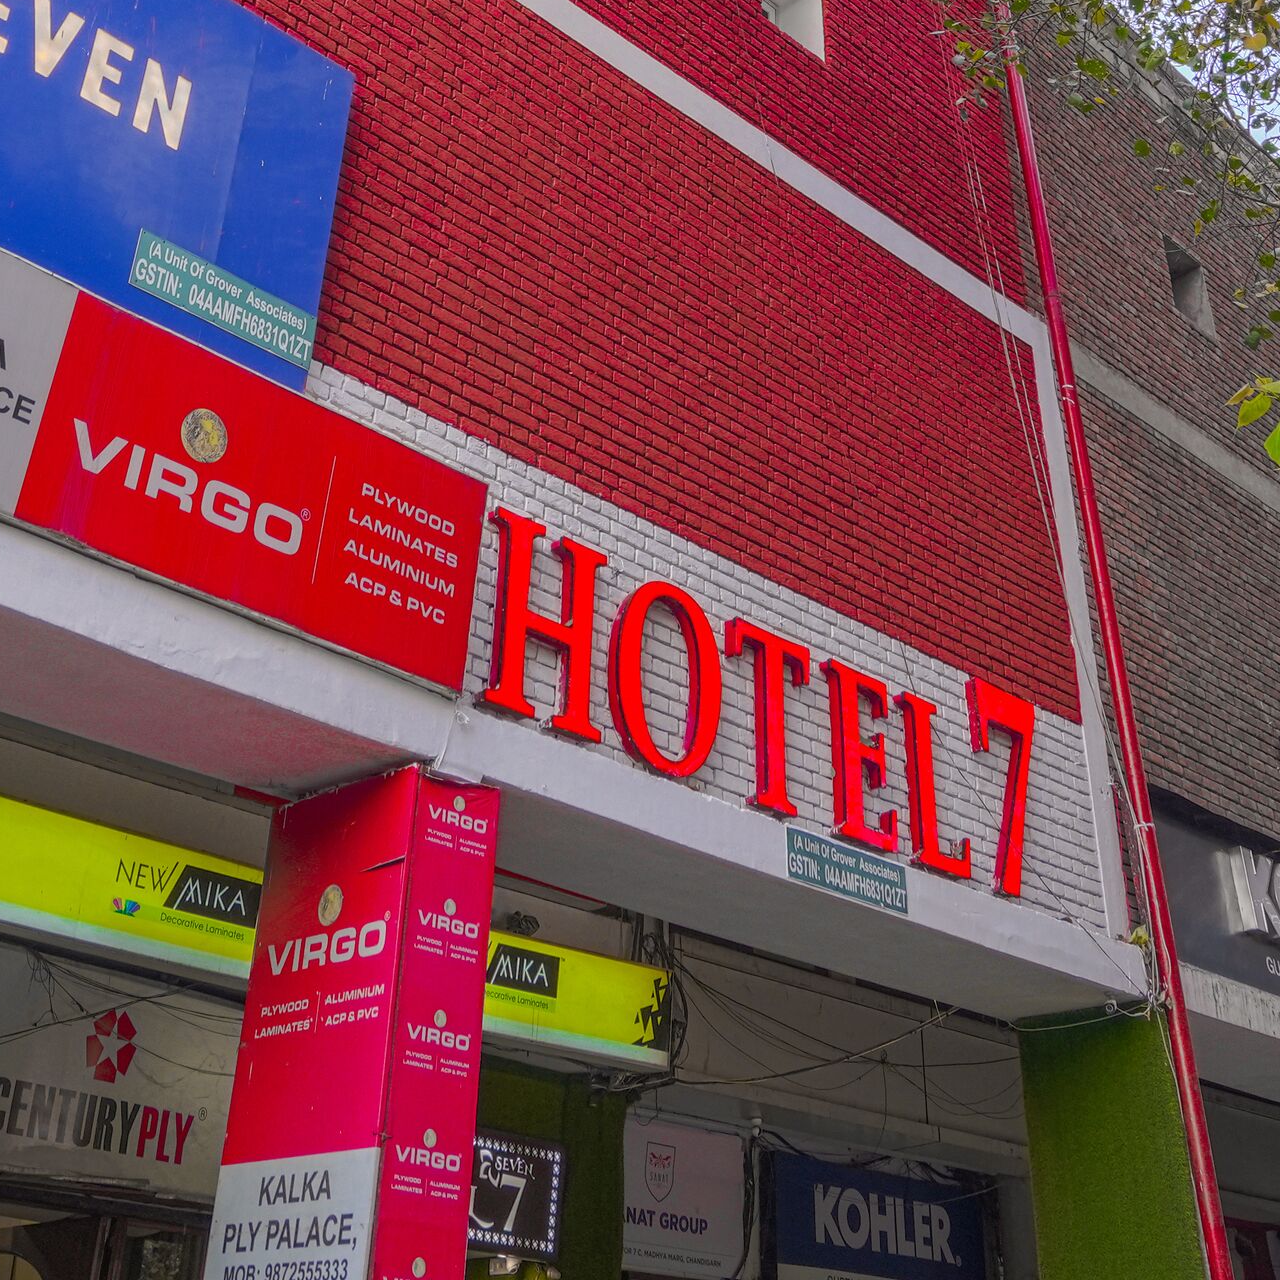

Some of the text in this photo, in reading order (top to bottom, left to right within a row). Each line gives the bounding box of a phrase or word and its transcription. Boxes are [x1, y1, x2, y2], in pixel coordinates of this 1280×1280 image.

[149, 240, 307, 335] (A Unit Of Grover Associates)
[135, 258, 311, 361] GSTIN: 04AAMFH6831Q1ZT
[74, 418, 303, 555] VIRGO
[362, 483, 455, 536] PLYWOOD
[348, 508, 458, 568] LAMINATES
[344, 539, 455, 598] ALUMINIUM
[344, 572, 446, 625] ACP & PVC
[473, 506, 1035, 897] HOTEL 7
[429, 803, 487, 834] VIRGO
[424, 835, 453, 848] LAMINATES
[427, 828, 452, 839] PLYWOOD
[459, 838, 487, 850] ALUMINIUM
[789, 852, 821, 880] GSTIN:
[794, 834, 901, 886] (A Unit Of Grover Associates)
[115, 858, 246, 916] NEW MIKA
[160, 911, 245, 941] Decorative Laminates
[418, 909, 478, 939] VIRGO
[268, 920, 388, 976] VIRGO
[414, 943, 443, 955] LAMINATES
[417, 935, 442, 946] PLYWOOD
[450, 944, 478, 955] ALUMINIUM
[490, 954, 548, 987] MIKA
[260, 999, 309, 1018] PLYWOOD
[325, 984, 385, 1005] ALUMINIUM
[486, 990, 548, 1009] ecorative Laminates
[254, 1019, 310, 1039] LAMINATES
[325, 1006, 379, 1026] ACP & PVC
[407, 1022, 469, 1051] VIRGO
[402, 1058, 433, 1070] LAMINATES
[405, 1050, 432, 1060] PLYWOOD
[440, 1058, 469, 1069] ALUMINIUM
[395, 1144, 460, 1172] VIRGO
[495, 1155, 535, 1180] SEVEN
[258, 1170, 331, 1206] KALKA
[391, 1184, 422, 1195] LAMINATES
[394, 1174, 421, 1184] PLYWOOD
[430, 1180, 460, 1191] ALUMINIUM
[500, 1174, 527, 1232] 7
[222, 1213, 357, 1254] PLY PALACE,
[660, 1212, 708, 1235] GROUP
[814, 1184, 957, 1265] KOHLER
[644, 1250, 667, 1260] MADHYA
